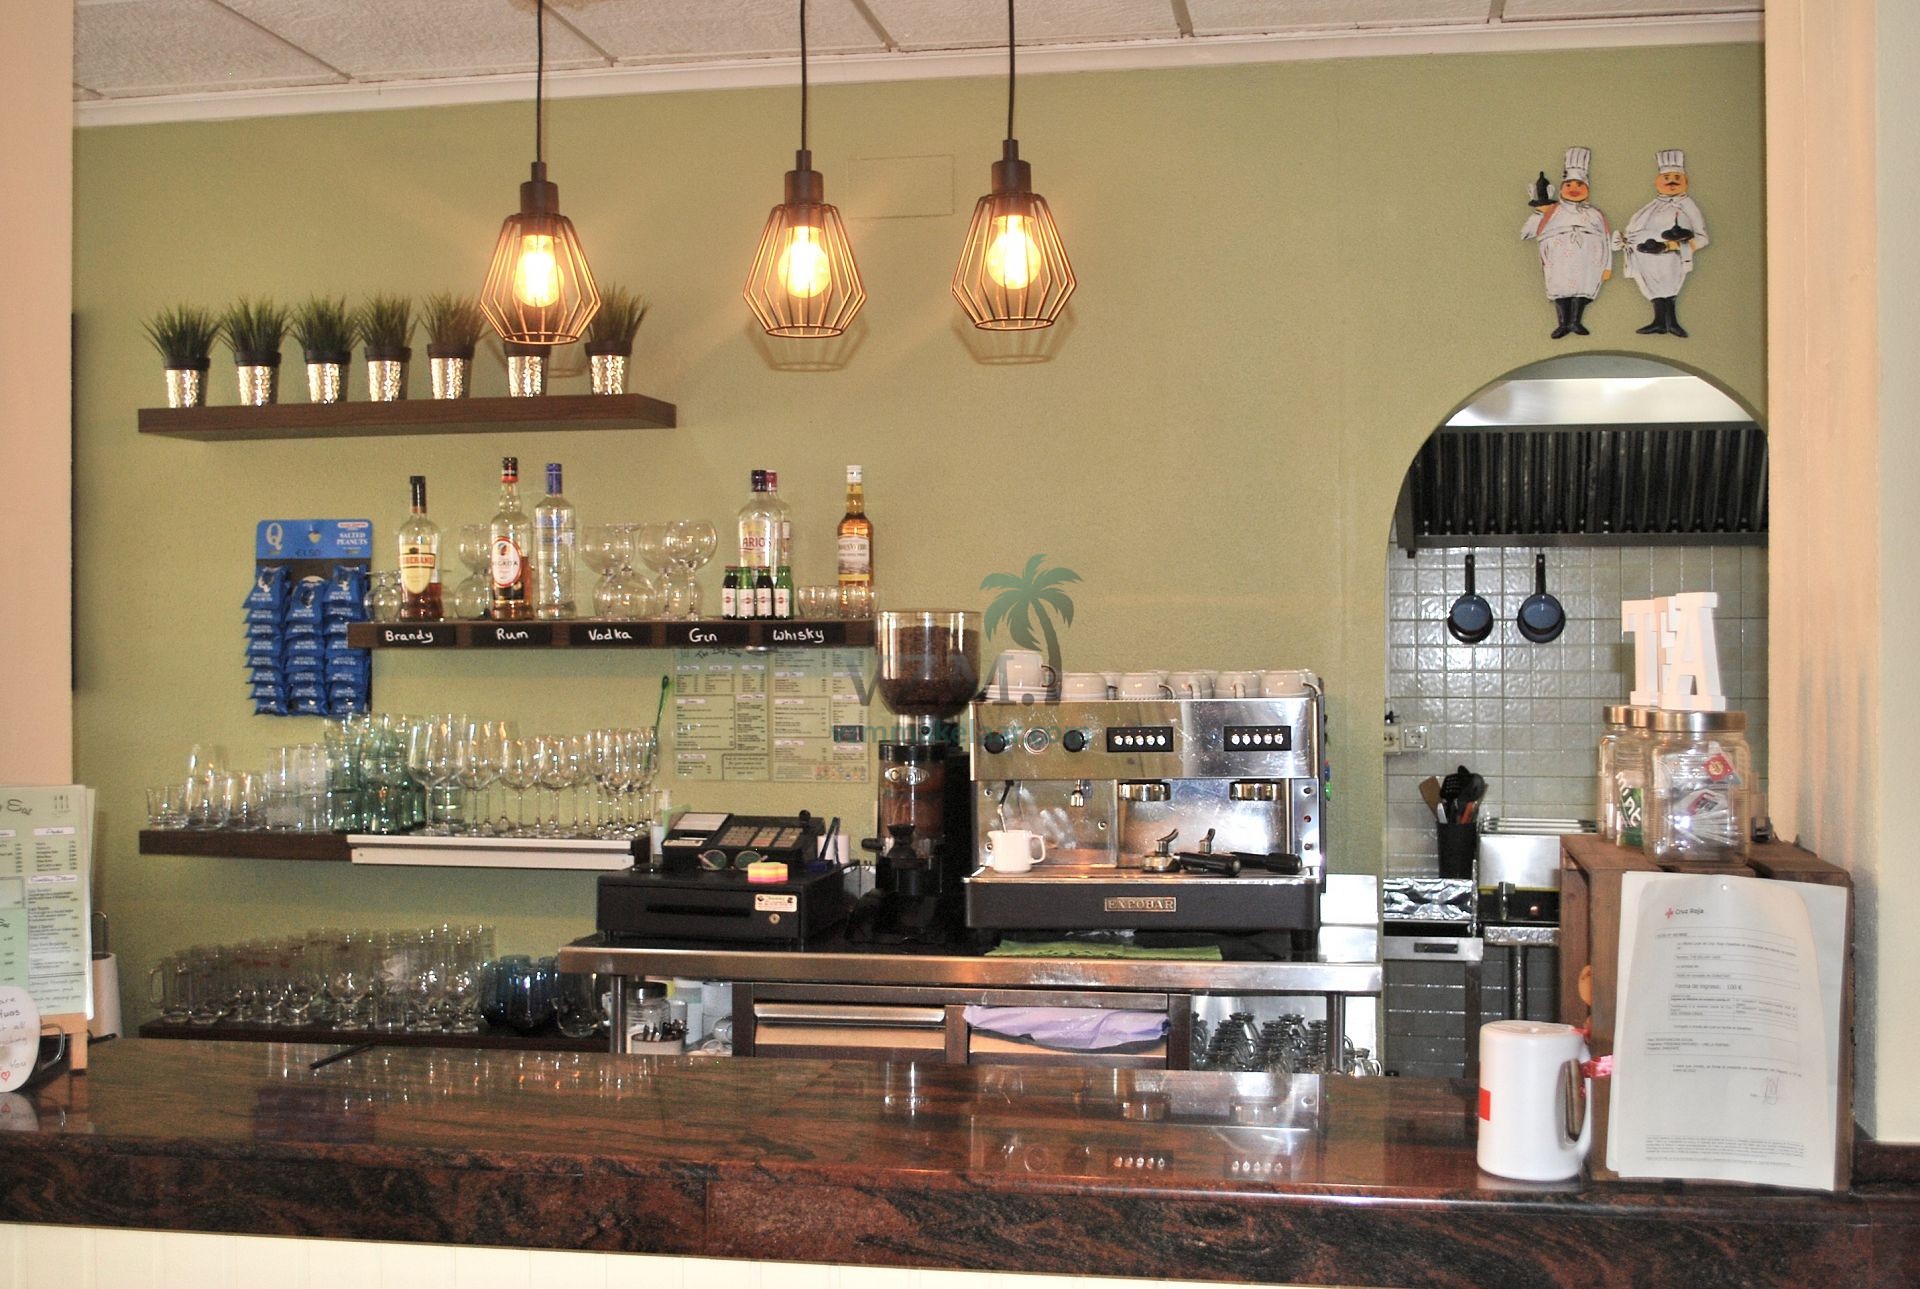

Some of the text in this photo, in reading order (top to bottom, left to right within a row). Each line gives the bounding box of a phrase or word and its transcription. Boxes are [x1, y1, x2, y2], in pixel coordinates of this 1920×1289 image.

[385, 630, 434, 643] Brandy
[496, 628, 528, 640] Rum
[588, 628, 633, 640] Vodka
[688, 628, 718, 642] Gin
[772, 629, 825, 644] Whisky
